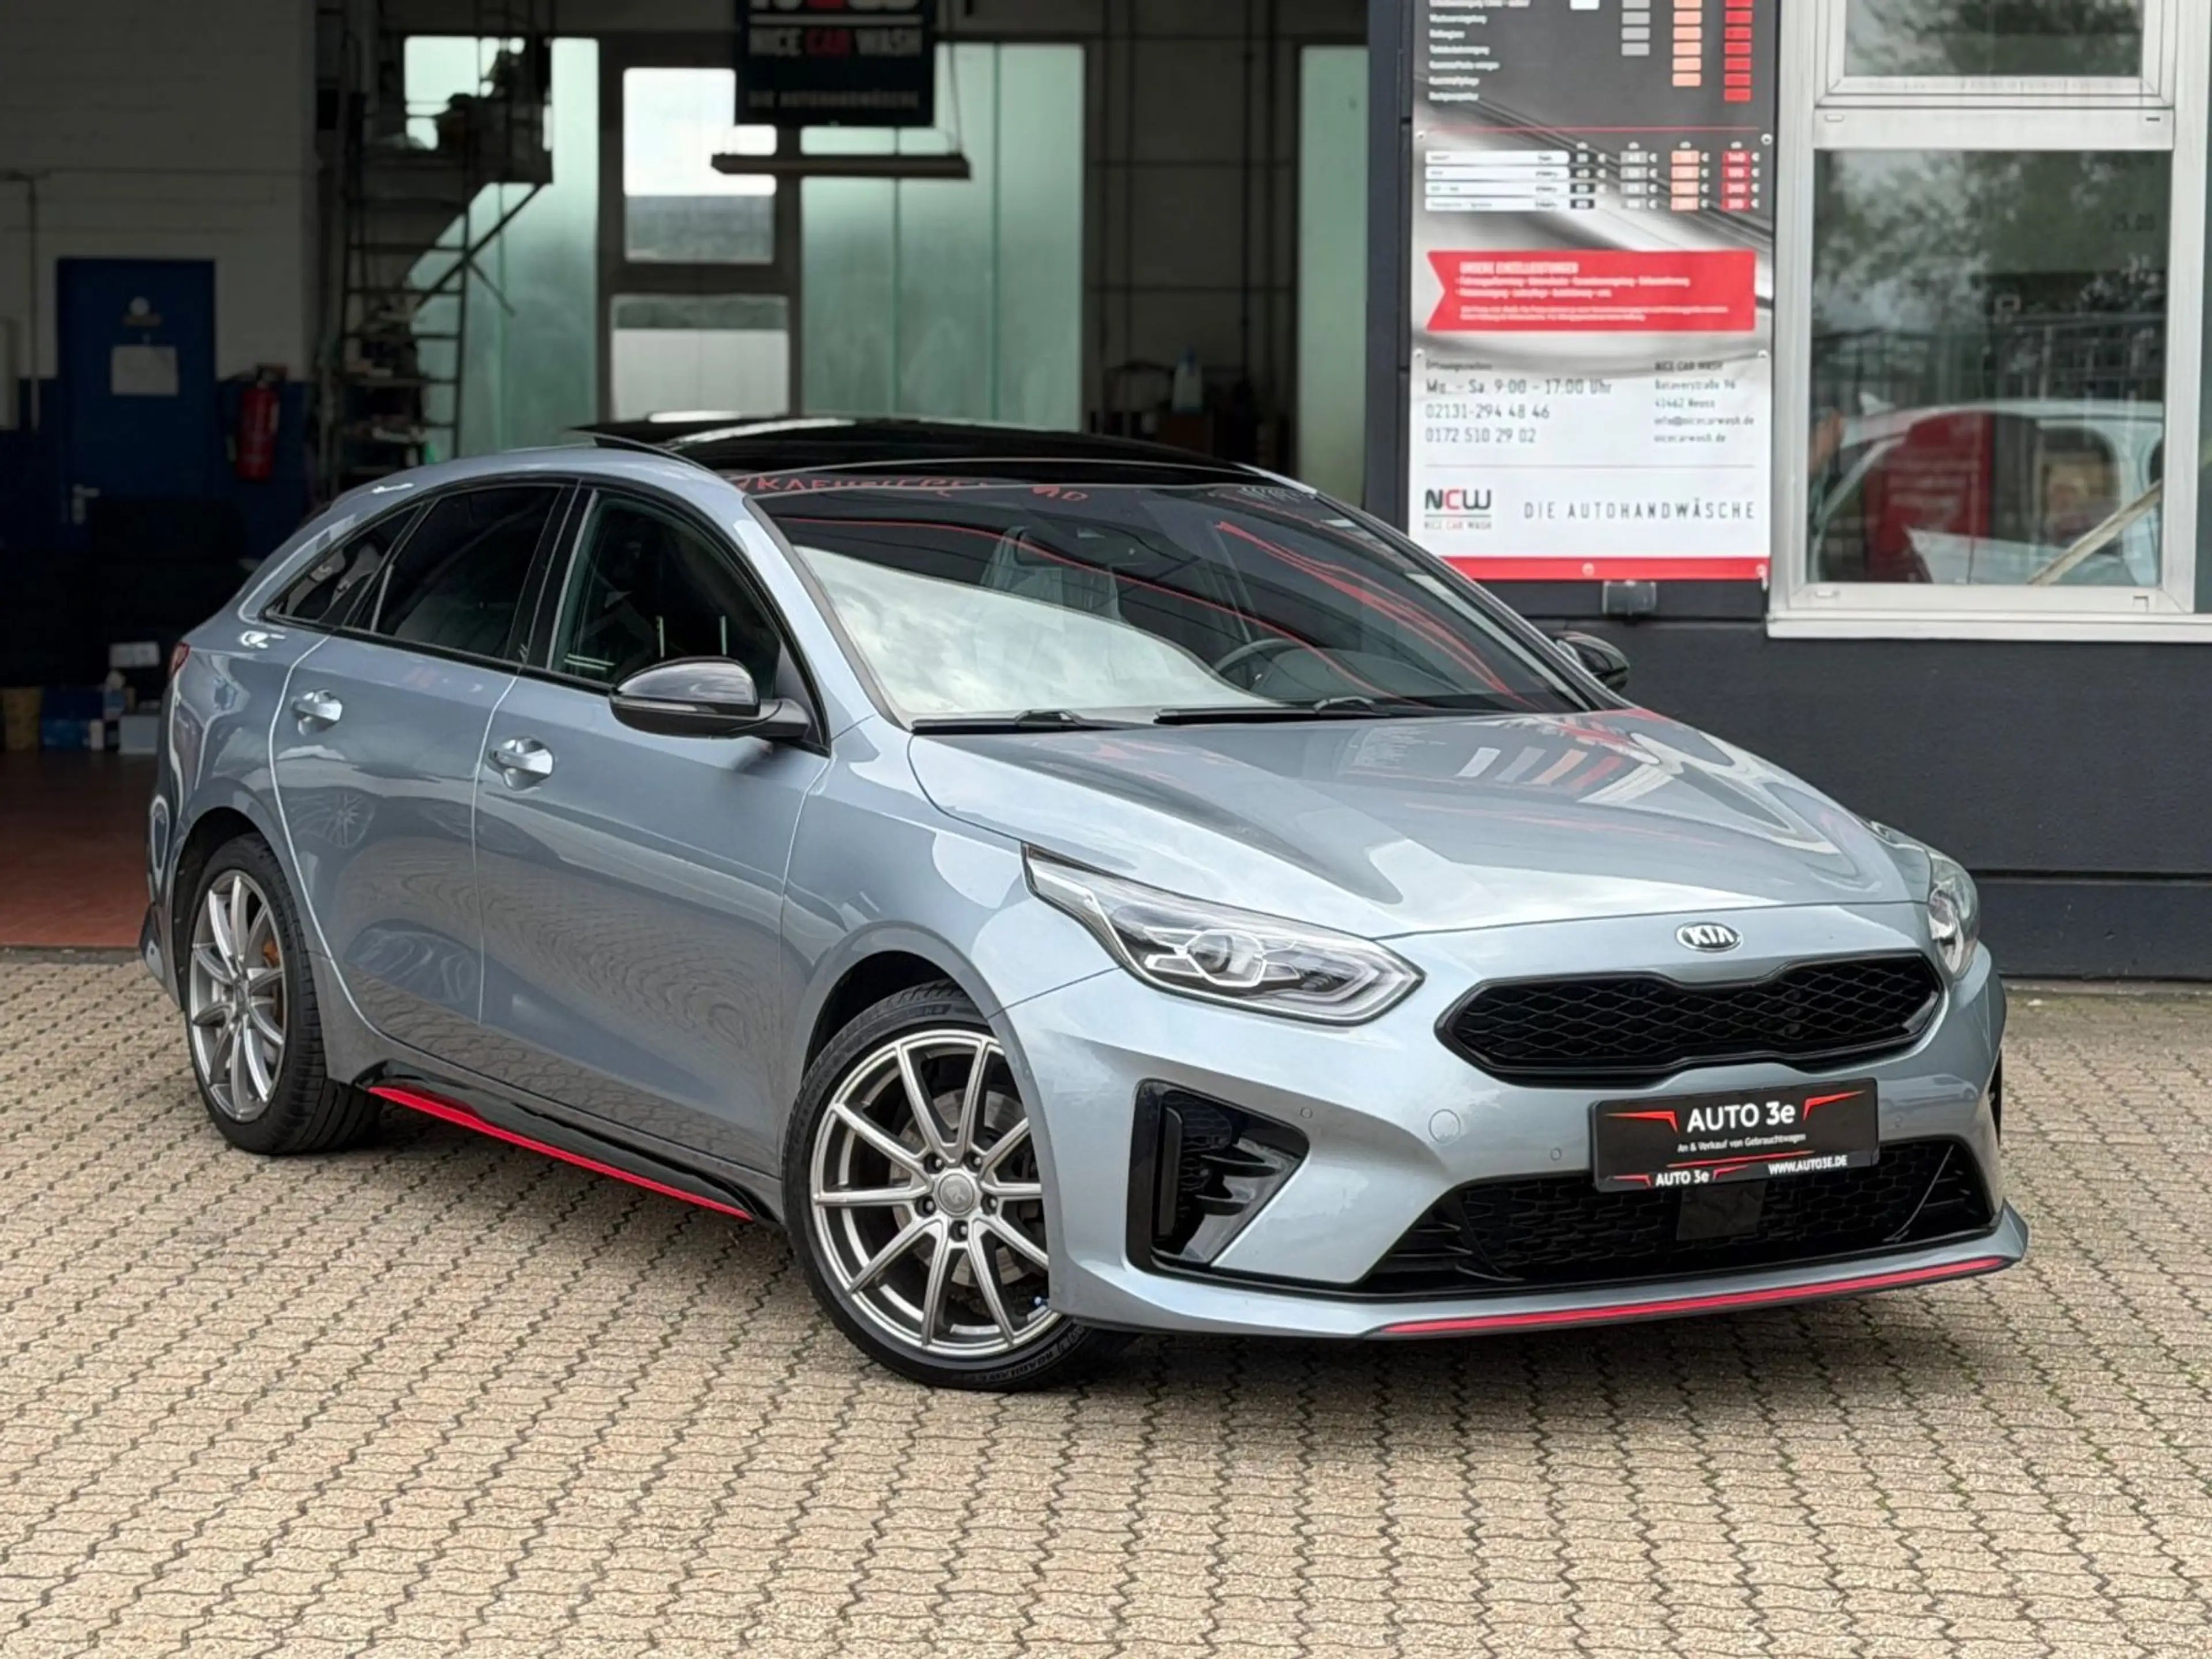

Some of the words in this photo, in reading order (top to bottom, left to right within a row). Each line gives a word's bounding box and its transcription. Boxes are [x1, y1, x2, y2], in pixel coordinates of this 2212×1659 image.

[1589, 377, 1612, 395] Uhr
[1425, 403, 1502, 419] 02131-294
[1508, 403, 1526, 419] 48
[1531, 403, 1550, 419] 46
[1425, 427, 1460, 443] 0172
[1464, 427, 1491, 443] 510
[1495, 427, 1513, 443] 29
[1518, 427, 1537, 443] 02
[1425, 488, 1491, 510] NCW
[1524, 501, 1555, 519] DIE
[1567, 497, 1756, 520] AUTOHANDWÄSCHE
[1683, 925, 1734, 945] KIA
[1686, 1103, 1760, 1133] AUTO
[1765, 1101, 1796, 1126] 3e
[1677, 1143, 1689, 1153] An
[1690, 1142, 1697, 1152] &
[1698, 1139, 1728, 1152] Verkauf
[1729, 1139, 1744, 1149] von
[1745, 1132, 1807, 1147] Gebrauchtwagen
[1767, 1154, 1848, 1175] WWW.AUTO3E.DE
[1655, 1170, 1691, 1187] AUTO
[1693, 1169, 1709, 1184] 3e
